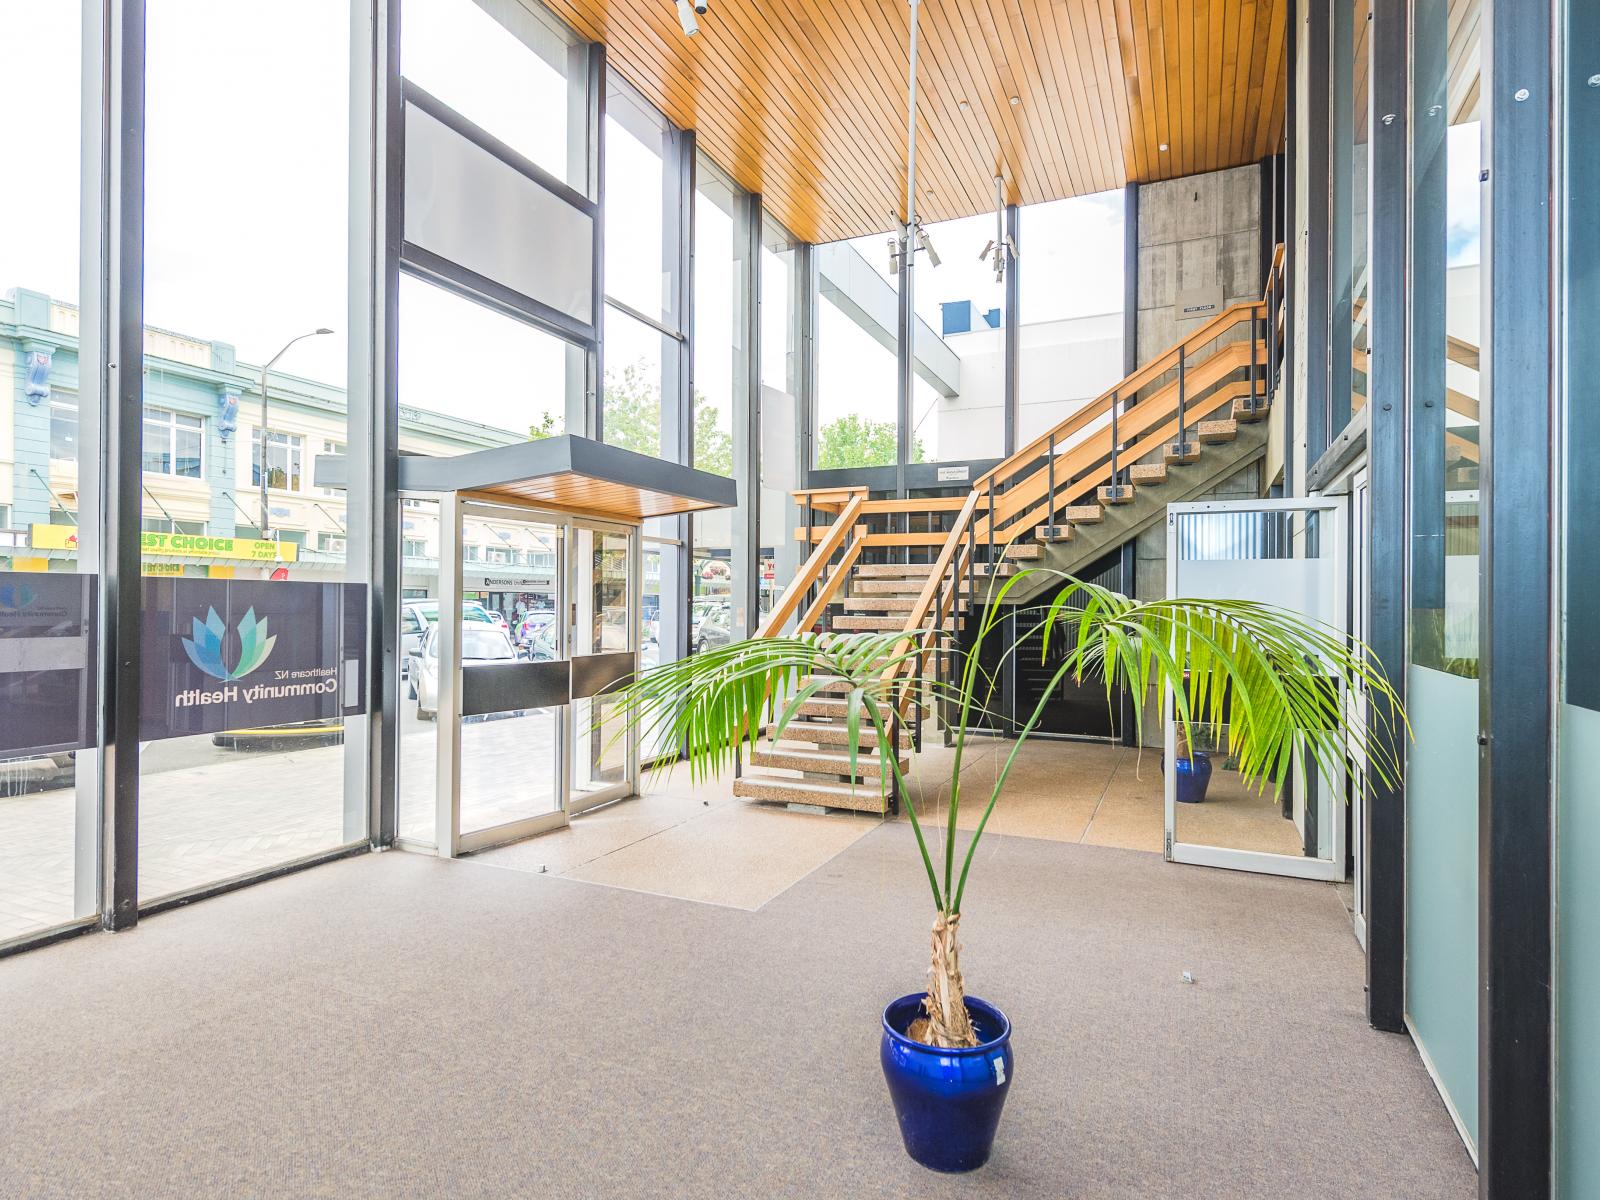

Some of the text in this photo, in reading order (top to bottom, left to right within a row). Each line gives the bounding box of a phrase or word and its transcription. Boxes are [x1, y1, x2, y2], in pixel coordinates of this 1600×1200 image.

[141, 533, 233, 551] EST CHOICE
[254, 542, 275, 550] OPEN
[484, 577, 512, 586] ANDERSONS
